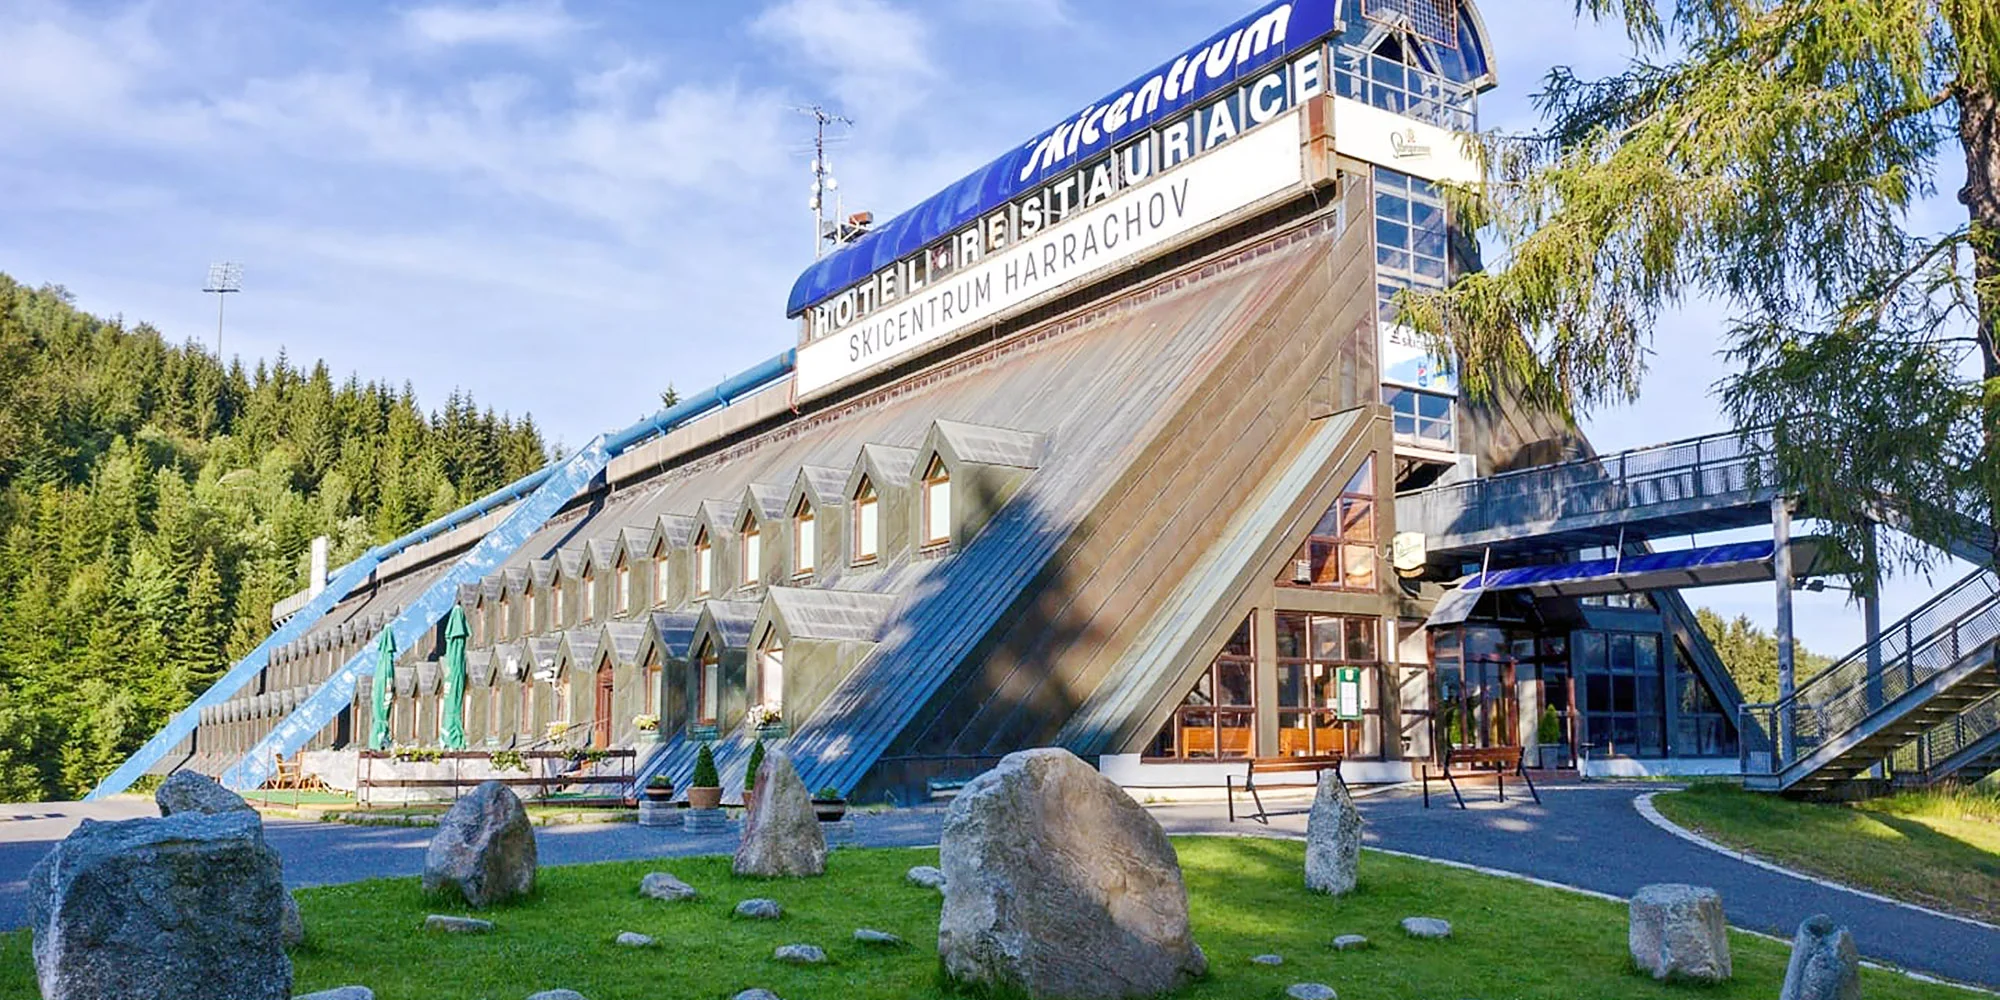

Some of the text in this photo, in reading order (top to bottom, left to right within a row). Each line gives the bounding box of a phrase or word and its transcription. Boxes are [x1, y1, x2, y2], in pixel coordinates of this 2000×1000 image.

[1020, 3, 1292, 182] skicentrum
[814, 50, 1320, 338] HOTEL RESTAURACE
[849, 178, 1189, 362] SKICENTRUM HARRACHOV
